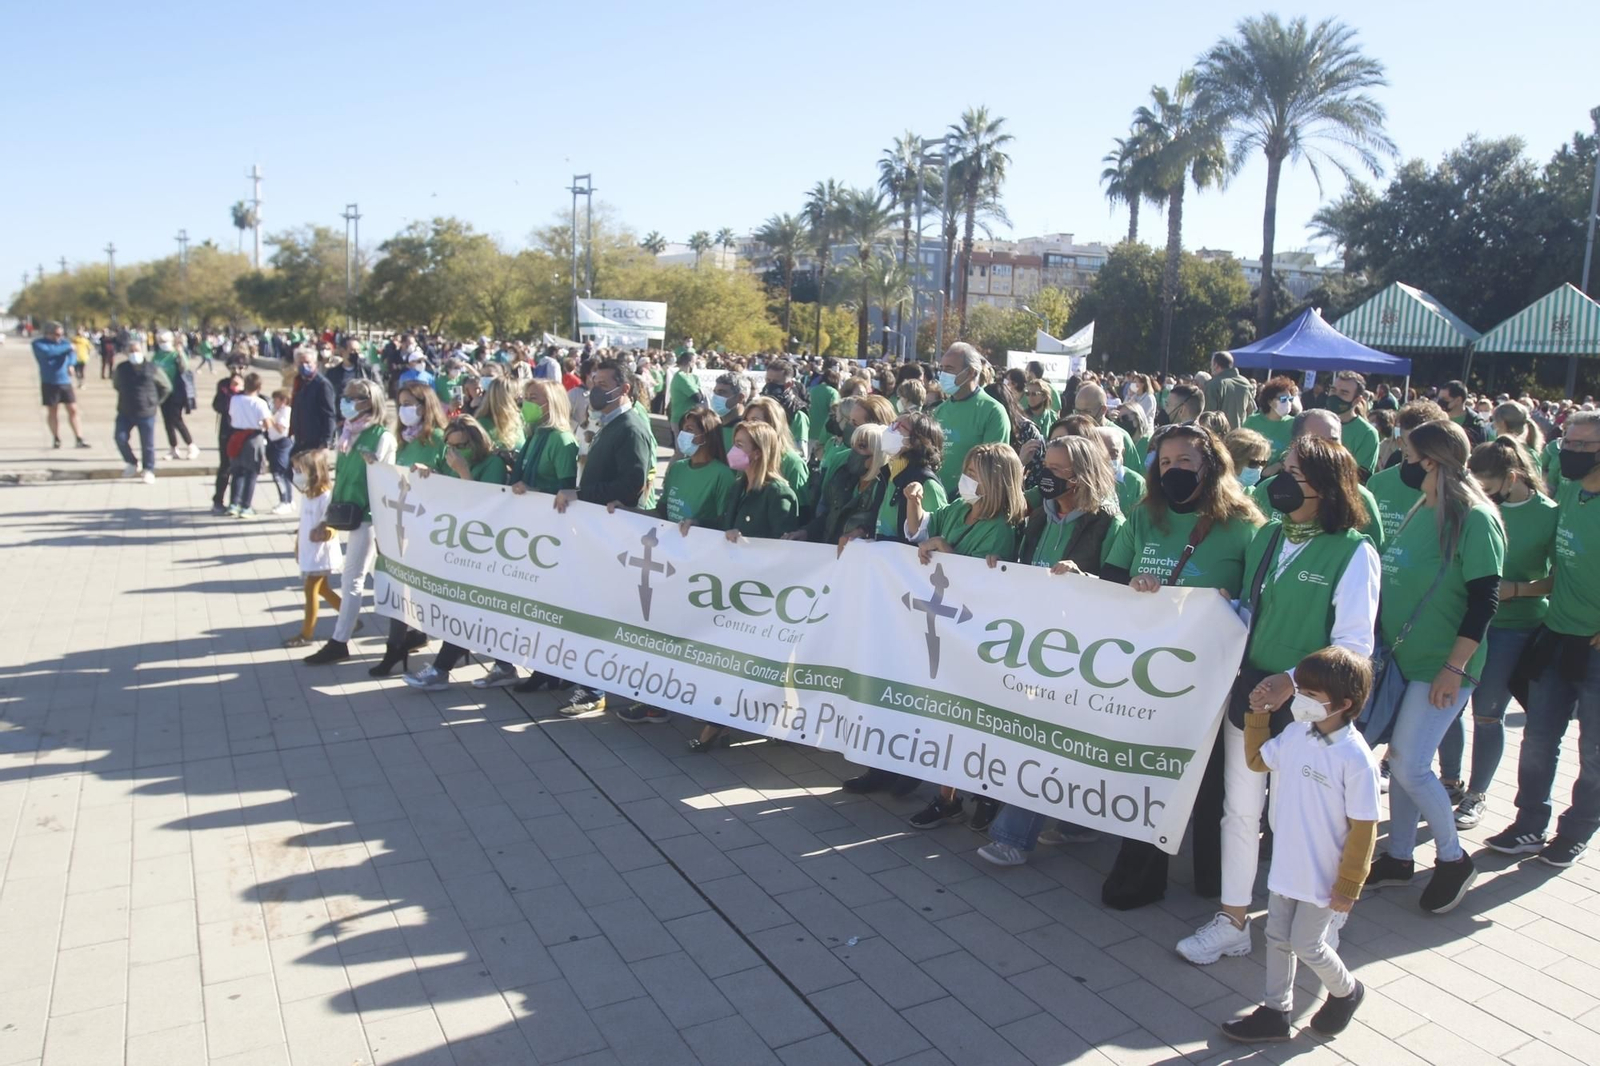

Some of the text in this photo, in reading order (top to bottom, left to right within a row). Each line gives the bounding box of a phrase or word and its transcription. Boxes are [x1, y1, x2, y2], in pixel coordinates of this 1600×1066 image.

[612, 307, 654, 319] aecc
[429, 513, 561, 569] aecc
[1140, 556, 1179, 567] marcha
[1143, 546, 1155, 555] En
[444, 552, 540, 583] Contra el Cáncer
[1138, 566, 1172, 575] contra
[422, 576, 467, 602] Española
[469, 590, 508, 611] Contra
[511, 600, 521, 614] el
[523, 602, 564, 625] Cáncer
[378, 582, 698, 706] Junta Provincial de Córdoba
[713, 614, 757, 635] Contra
[761, 626, 773, 639] el
[614, 626, 682, 658] Asociación
[684, 644, 741, 672] Española
[744, 660, 780, 682] Contra
[793, 669, 844, 690] Cáncer
[977, 618, 1196, 698] aecc
[1002, 674, 1157, 720] Contra el Cáncer
[729, 689, 807, 733] Junta
[963, 742, 1006, 787] de
[880, 686, 972, 722] Asociación
[976, 708, 1046, 745] Española
[1051, 731, 1108, 764] Contra
[1114, 749, 1132, 768] el
